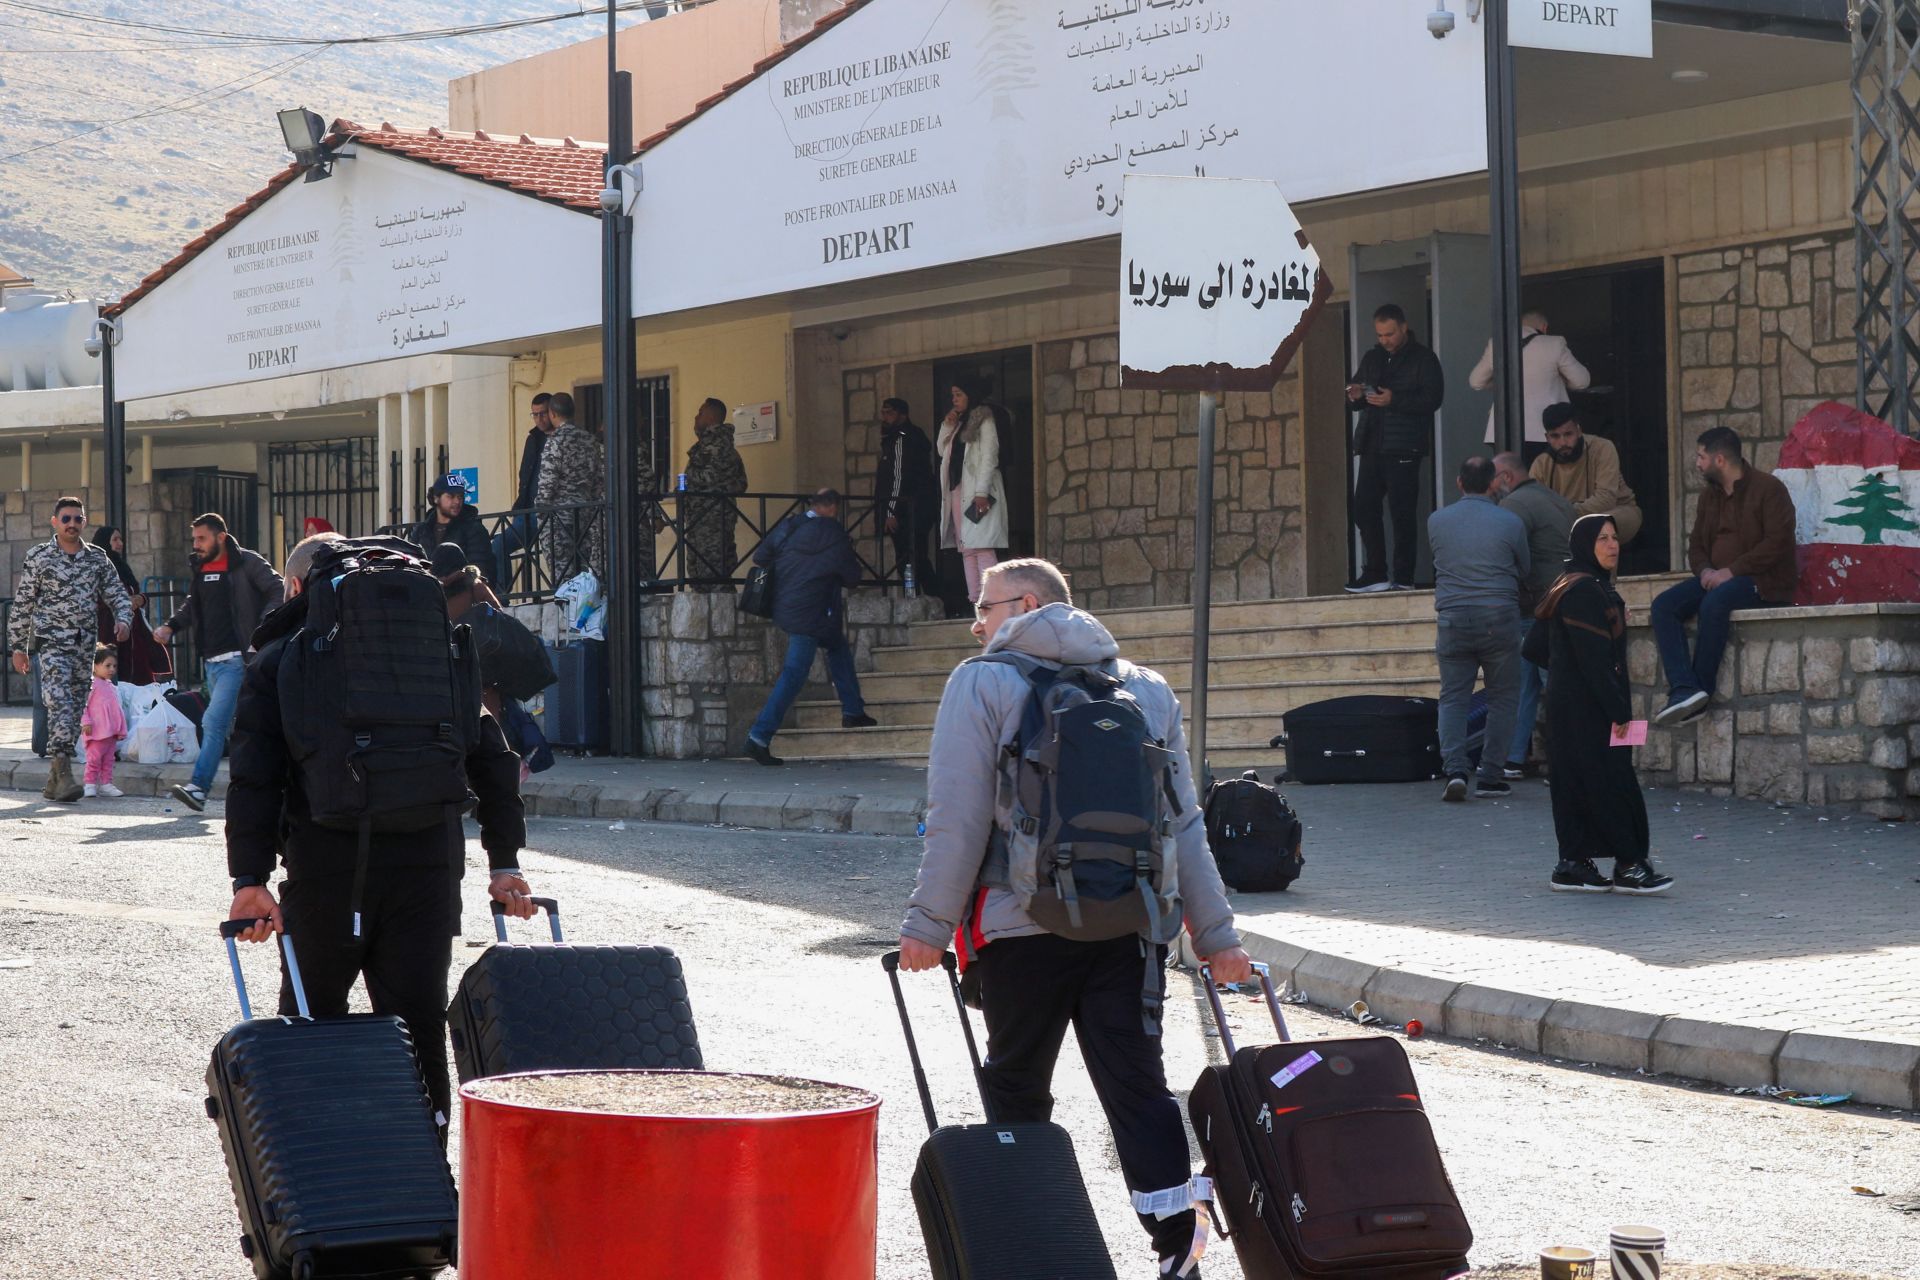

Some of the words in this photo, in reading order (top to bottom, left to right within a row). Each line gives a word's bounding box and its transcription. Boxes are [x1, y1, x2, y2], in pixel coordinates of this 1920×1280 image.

[1195, 10, 1230, 34] وزارة
[1542, 2, 1618, 27] DEPART
[1066, 32, 1132, 59] والبلديات
[1136, 16, 1190, 46] الداخلية
[783, 60, 871, 98] REPUBLIQUE
[874, 41, 951, 76] LIBANAISE
[1092, 68, 1137, 92] العامة
[1141, 54, 1204, 86] المديرية
[794, 93, 851, 121] MINISTERE
[854, 90, 869, 107] DE
[871, 73, 941, 103] L'INTERIEUR
[1148, 88, 1188, 119] للأمن
[1109, 99, 1142, 130] العام
[794, 133, 850, 159] DIRECTION
[851, 121, 908, 146] GENERALE
[910, 117, 925, 134] DE
[927, 114, 942, 130] LA
[1127, 129, 1189, 167] المصنع
[1196, 123, 1239, 151] مركز
[819, 160, 859, 182] SURETE
[860, 148, 918, 173] GENERALE
[1064, 143, 1122, 179] الحدودي
[784, 206, 817, 227] POSTE
[819, 192, 887, 220] FRONTALIER
[889, 189, 904, 206] DE
[907, 179, 957, 202] MASNAA
[227, 238, 277, 260] REPUBLIQUE
[277, 230, 320, 250] LIBANAISE
[822, 221, 914, 264] DEPART
[233, 258, 266, 274] MINISTERE
[266, 256, 275, 269] DE
[233, 286, 265, 300] DIRECTION
[264, 279, 296, 295] GENERALE
[296, 278, 306, 289] DE
[305, 276, 314, 287] LA
[1129, 258, 1190, 308] سوريا
[1198, 261, 1233, 310] الى
[246, 303, 269, 317] SURETE
[269, 297, 301, 312] GENERALE
[227, 331, 246, 344] POSTE
[246, 325, 284, 341] FRONTALIER
[284, 323, 294, 335] DE
[294, 319, 322, 333] MASNAA
[392, 320, 449, 350] المغادرة
[248, 345, 298, 370] DEPART
